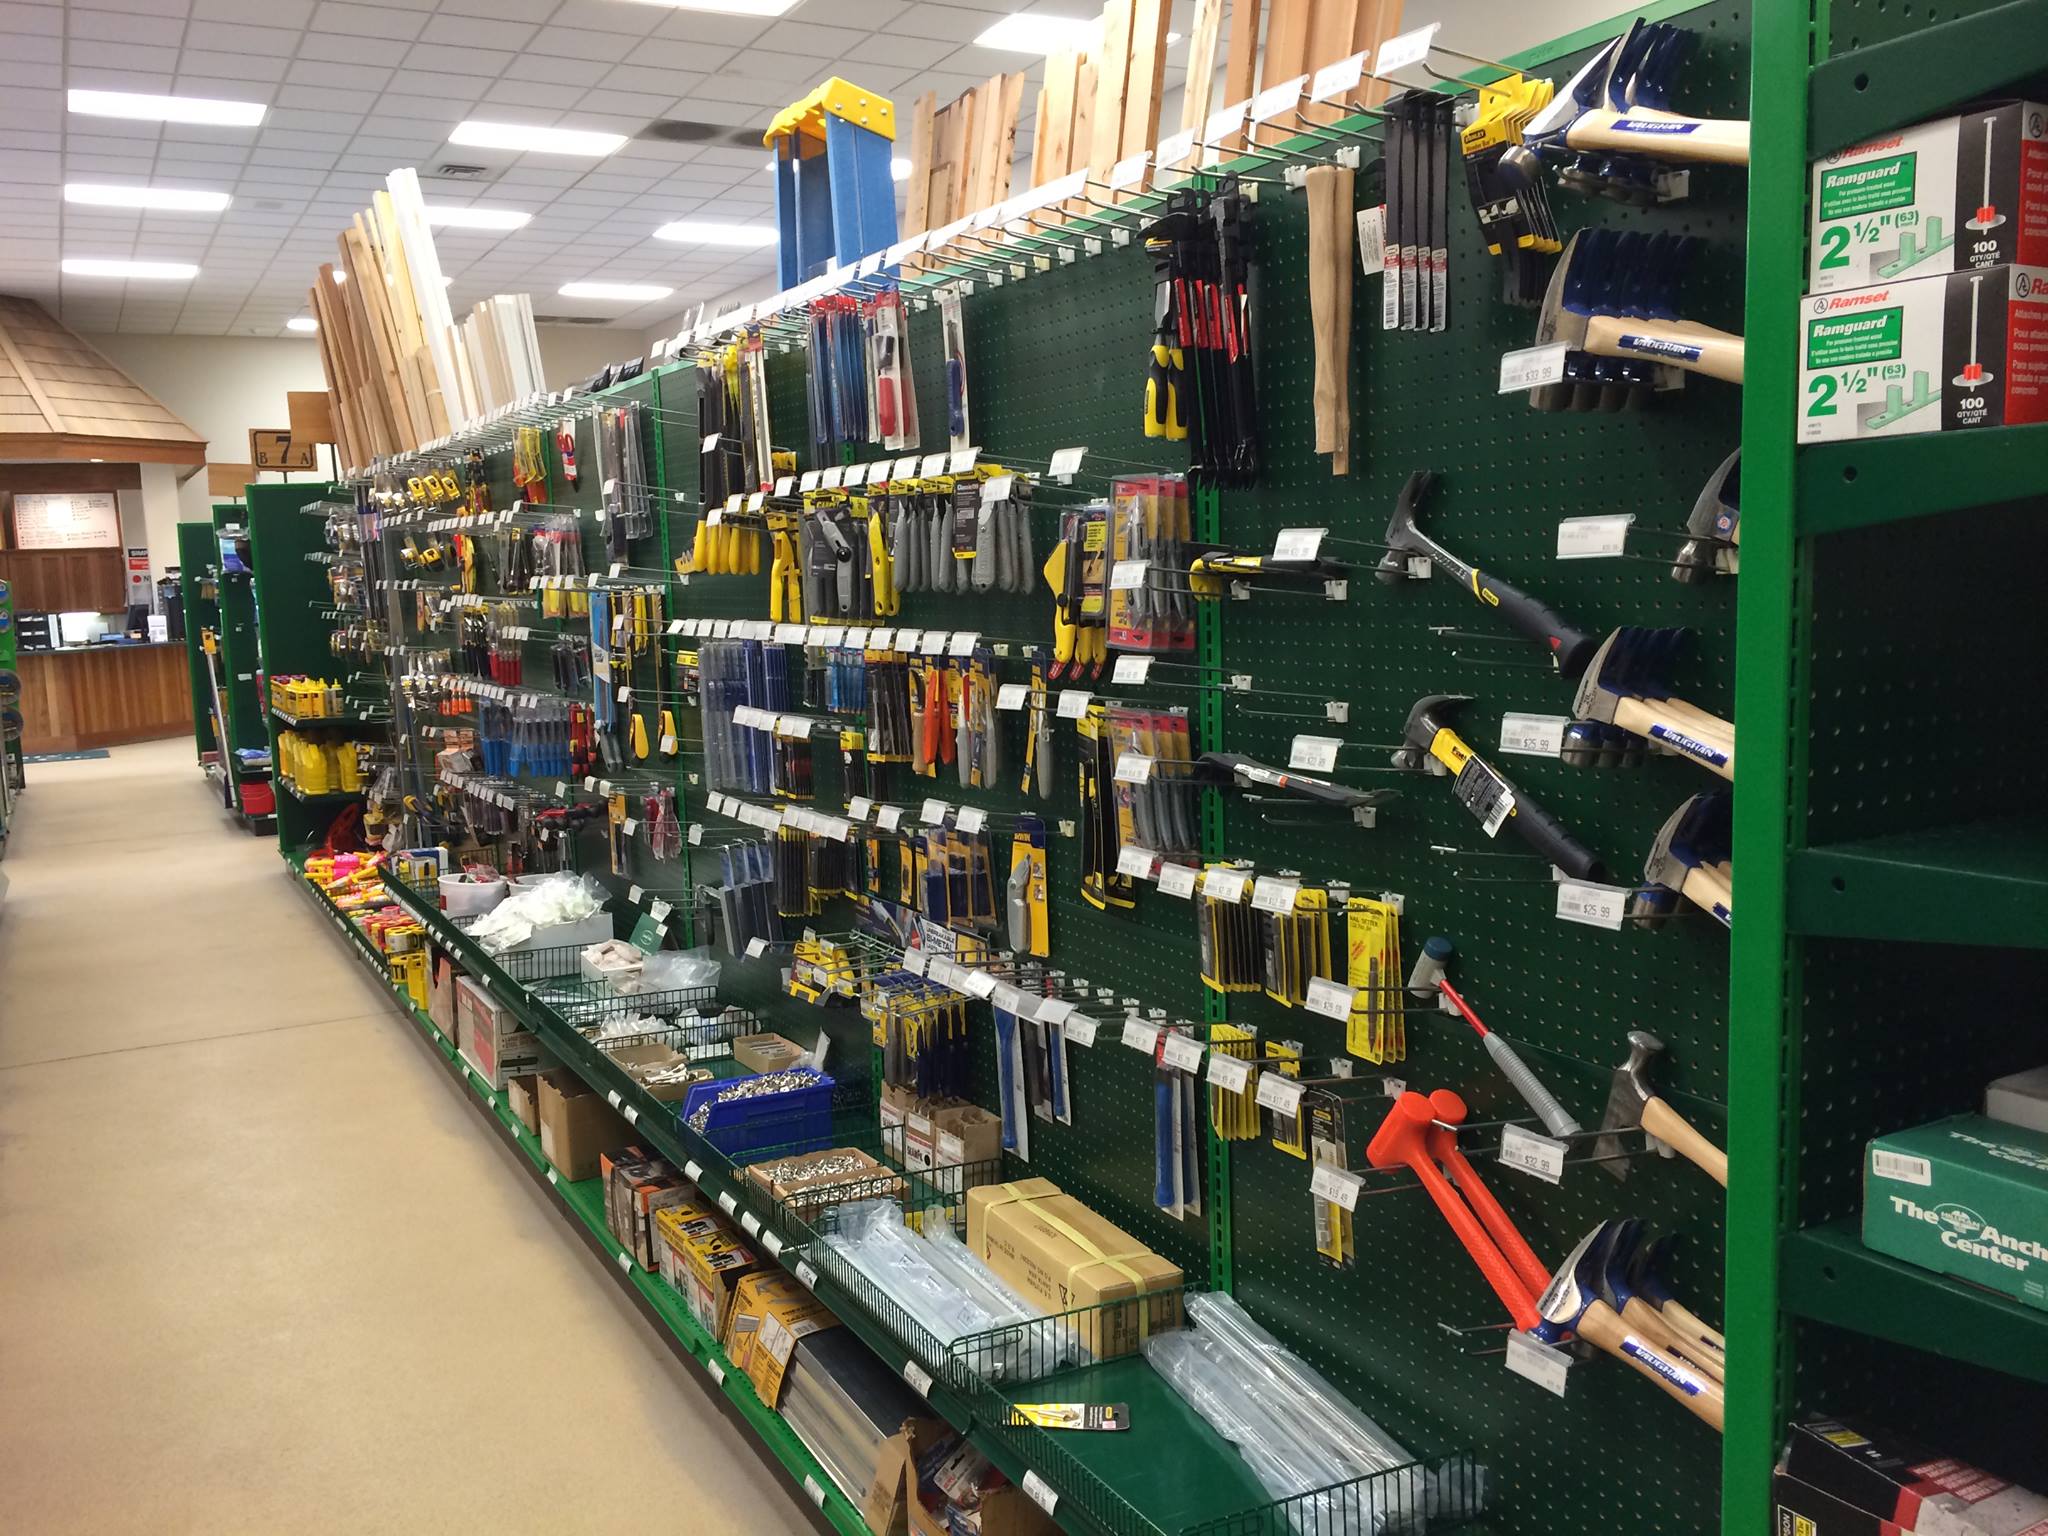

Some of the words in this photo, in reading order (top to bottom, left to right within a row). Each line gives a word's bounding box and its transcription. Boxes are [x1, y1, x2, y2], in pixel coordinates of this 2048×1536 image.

[1825, 161, 1901, 189] Ramguard
[1972, 239, 1998, 254] 100
[1829, 290, 1890, 310] Ramset
[1813, 315, 1888, 338] Ramguard
[1960, 397, 1985, 410] 100
[1962, 416, 1982, 425] CANT
[259, 451, 269, 464] B
[275, 435, 291, 464] 7
[300, 452, 310, 465] A
[1662, 728, 1715, 758] VAUGHAN
[1889, 1195, 1939, 1224] The
[1940, 1230, 2030, 1272] Center
[1980, 1225, 2048, 1262] Anch
[1635, 1346, 1689, 1385] VAUGHAN
